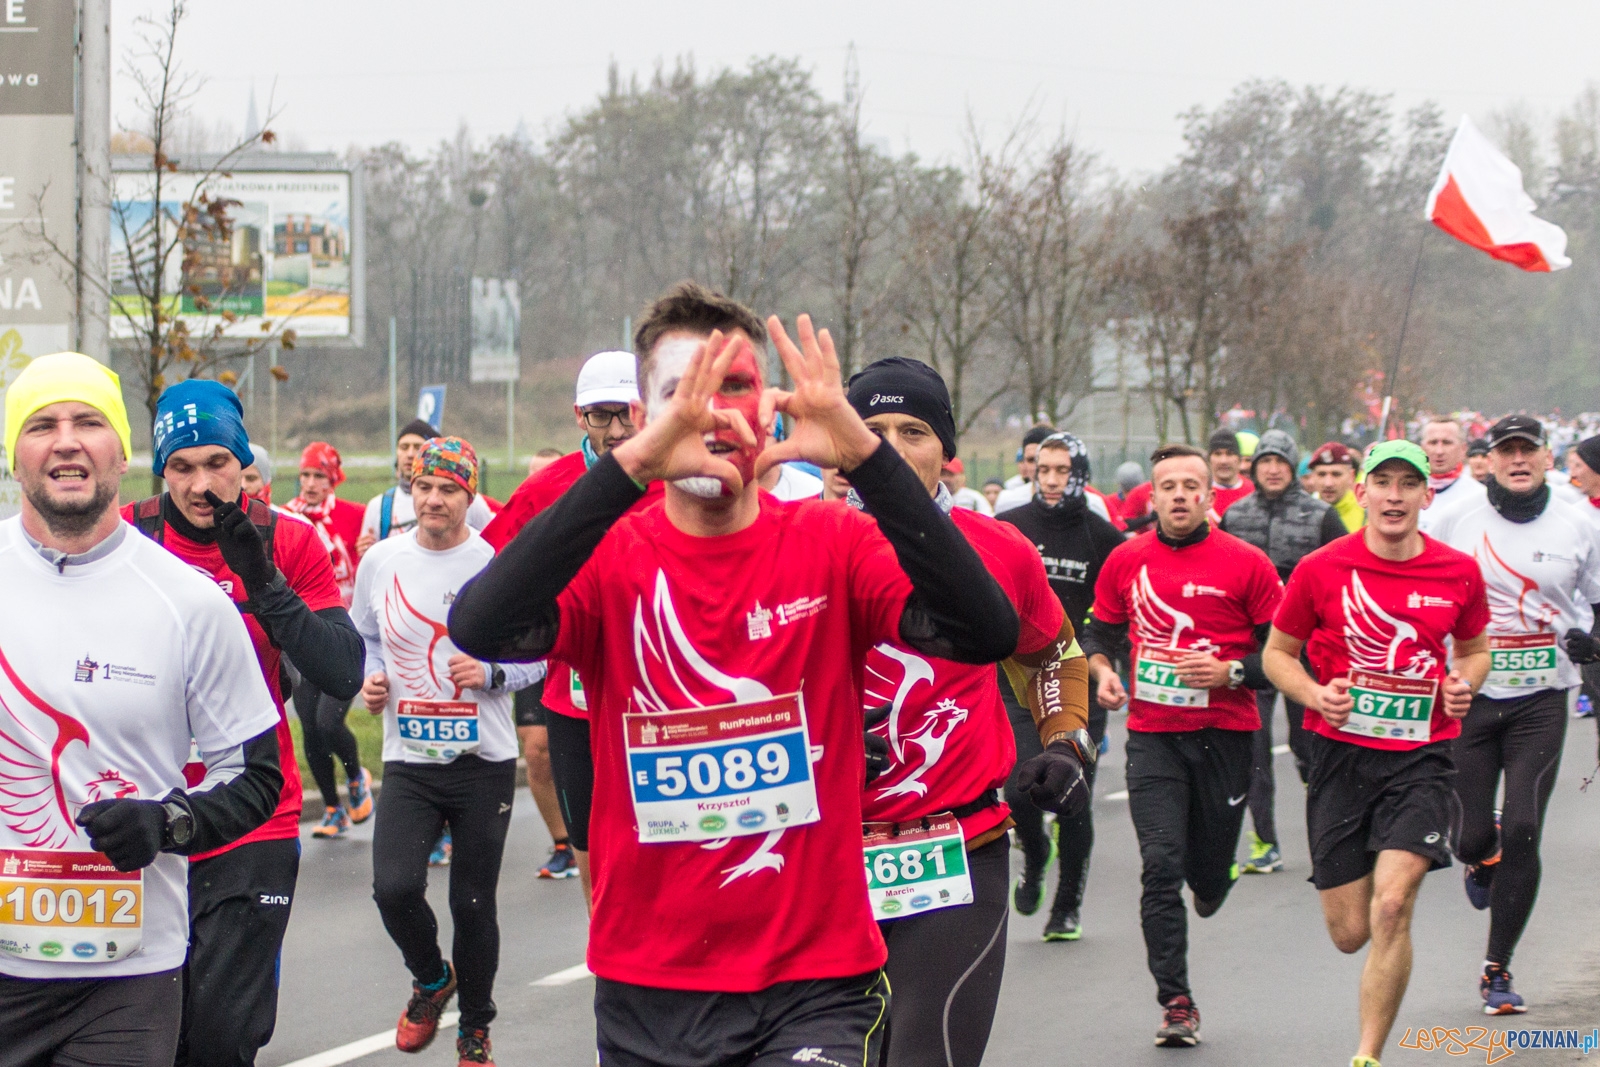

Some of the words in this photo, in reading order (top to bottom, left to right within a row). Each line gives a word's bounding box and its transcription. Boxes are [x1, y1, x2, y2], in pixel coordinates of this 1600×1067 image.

[1493, 651, 1550, 669] 5562
[1357, 693, 1422, 719] 6711
[407, 719, 470, 741] 9156
[719, 711, 791, 731] RunPoland.org
[636, 770, 649, 785] E
[656, 742, 790, 797] 5089
[697, 797, 751, 811] Krzysztof
[885, 887, 915, 897] Marcin
[6, 886, 137, 924] 10012
